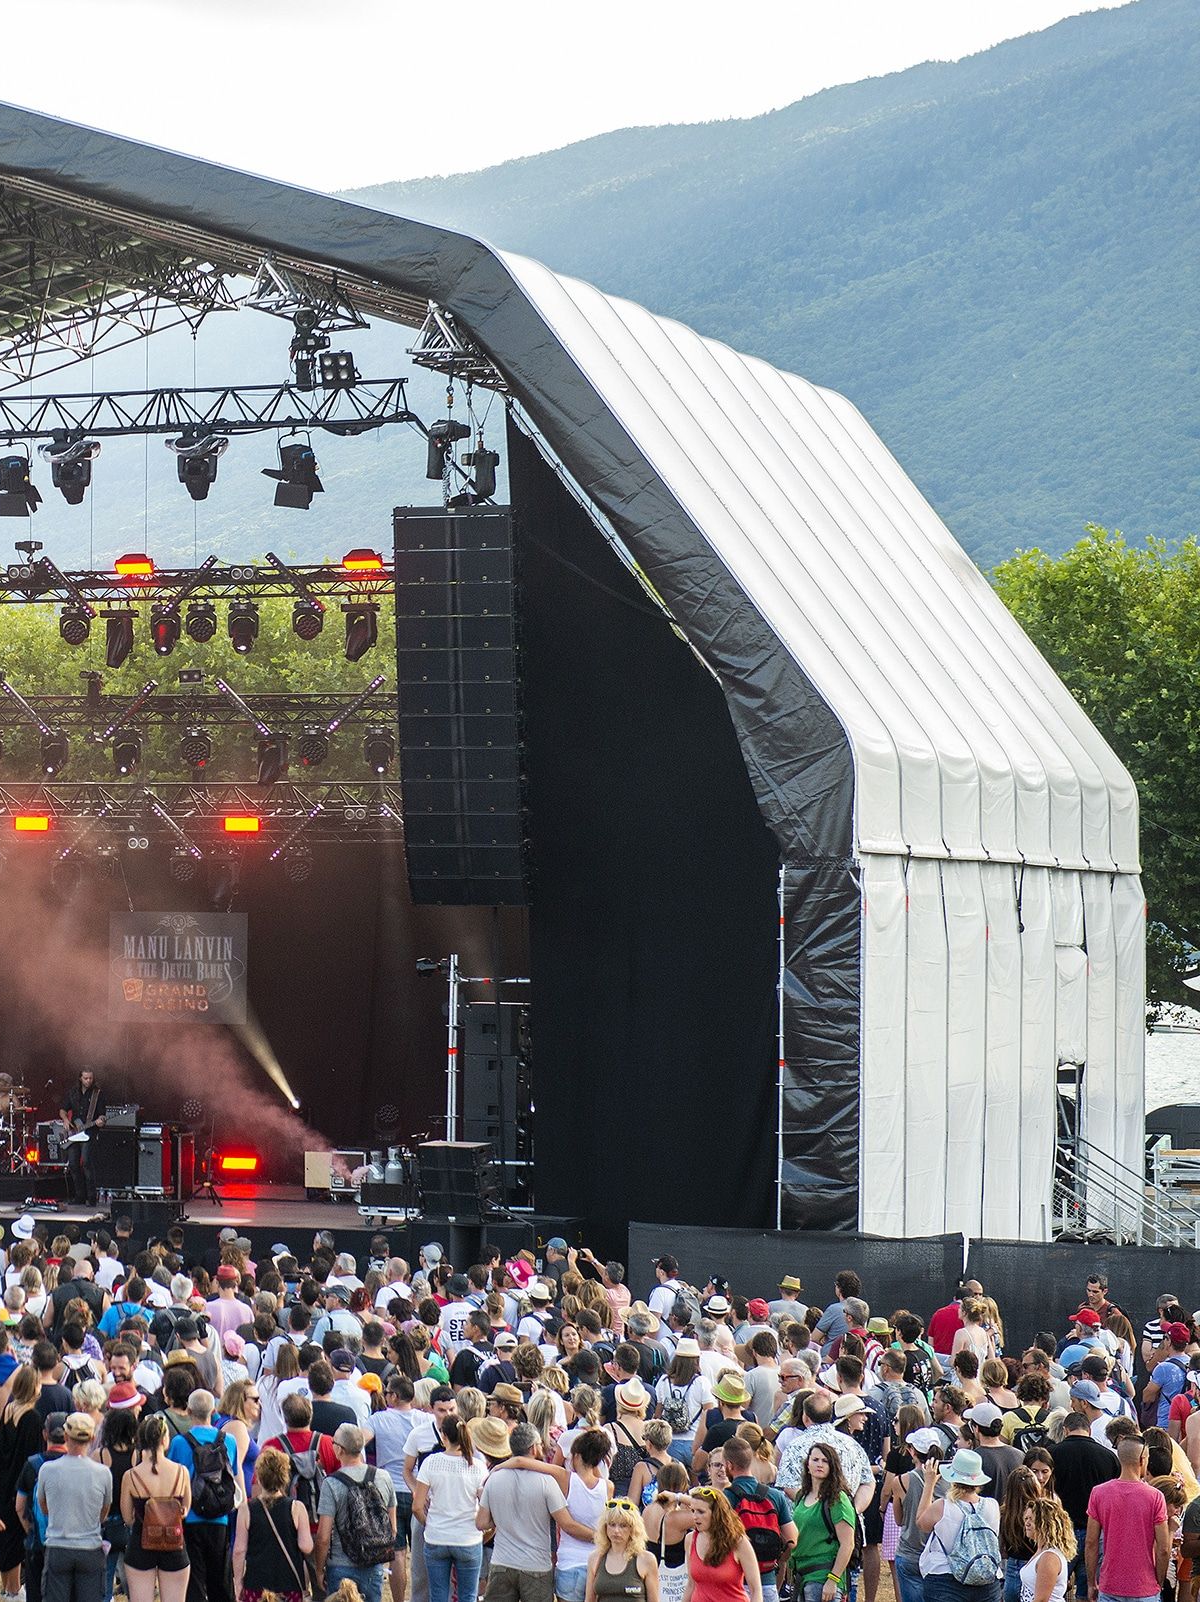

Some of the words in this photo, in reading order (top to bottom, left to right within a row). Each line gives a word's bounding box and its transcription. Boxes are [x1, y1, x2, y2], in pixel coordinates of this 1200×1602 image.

[123, 935, 168, 960] MANU
[173, 935, 233, 961] LANVIN
[145, 984, 207, 998] GRAND
[143, 998, 209, 1012] CASINO
[449, 1319, 467, 1331] ST
